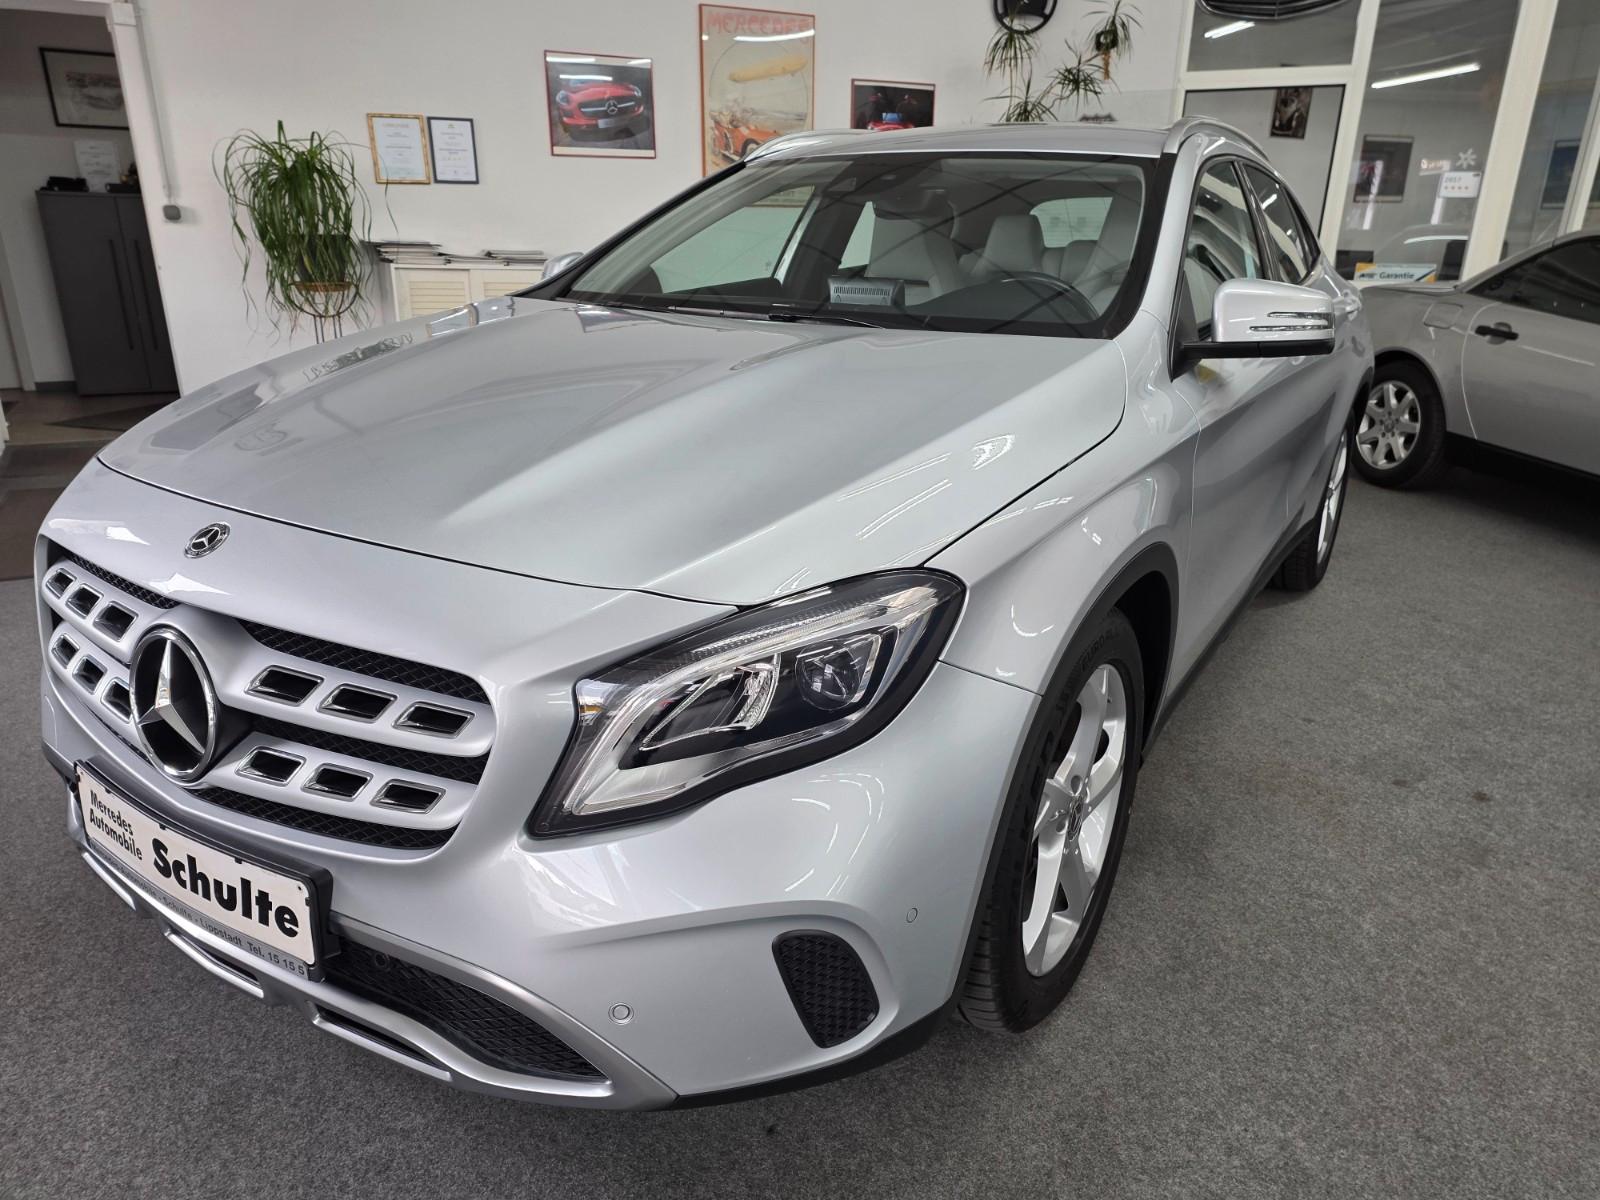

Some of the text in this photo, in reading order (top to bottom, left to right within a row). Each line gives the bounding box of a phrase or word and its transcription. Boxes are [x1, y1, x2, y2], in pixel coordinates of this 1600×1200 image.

[1379, 271, 1415, 280] Garantie
[89, 809, 143, 861] Automobile
[90, 789, 134, 837] Mercedes
[152, 838, 299, 938] Schulte
[200, 917, 241, 945] Lippstadt
[247, 941, 265, 958] Tel.
[268, 951, 280, 965] 15
[283, 958, 296, 972] 15
